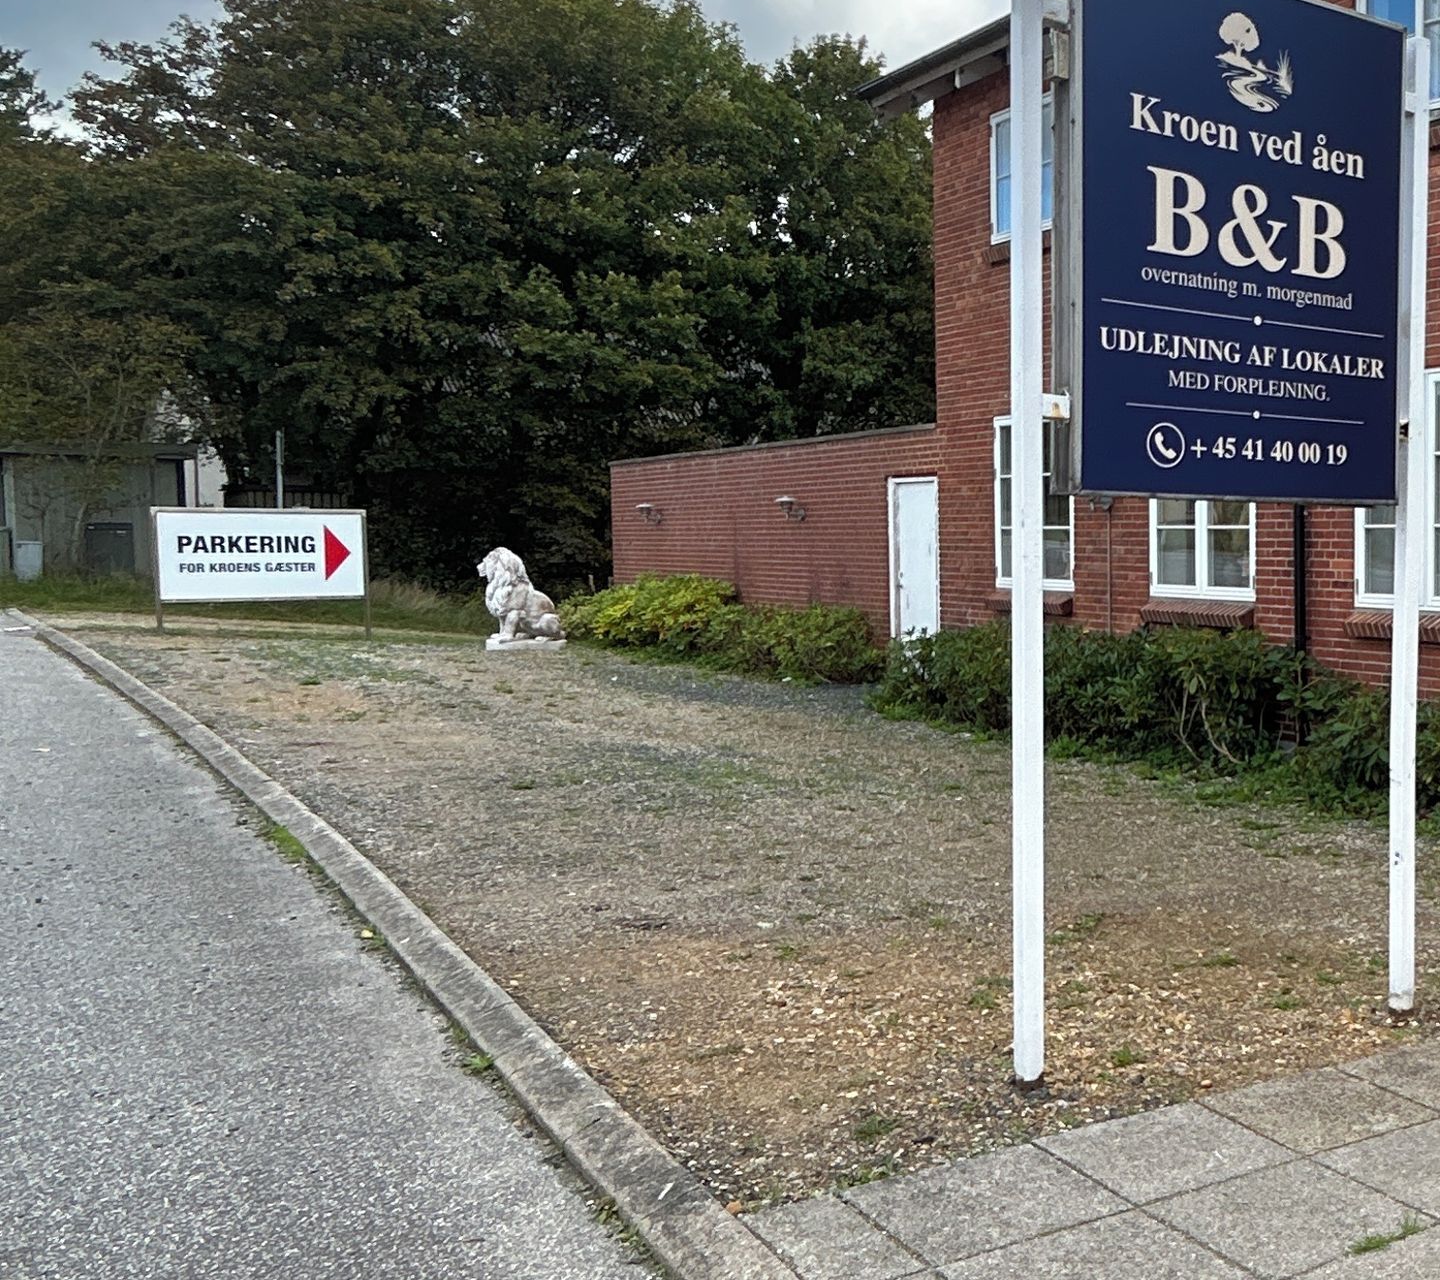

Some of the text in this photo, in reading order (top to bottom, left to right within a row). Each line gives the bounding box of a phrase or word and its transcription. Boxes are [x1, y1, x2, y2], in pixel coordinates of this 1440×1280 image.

[1129, 92, 1365, 179] Kroen ved åen
[1146, 165, 1346, 279] B&B
[1141, 266, 1353, 310] overnatning m. morgenmad
[1099, 326, 1385, 379] UDLEJNING AF LOKALER
[1168, 369, 1330, 401] MED FORPLEJNING.
[1241, 438, 1264, 461] 41
[1270, 440, 1294, 463] 40
[1297, 441, 1321, 464] 00
[1326, 444, 1348, 466] 19
[177, 535, 316, 554] PARKERING
[179, 562, 316, 573] FOR KROENS GÆSTER
